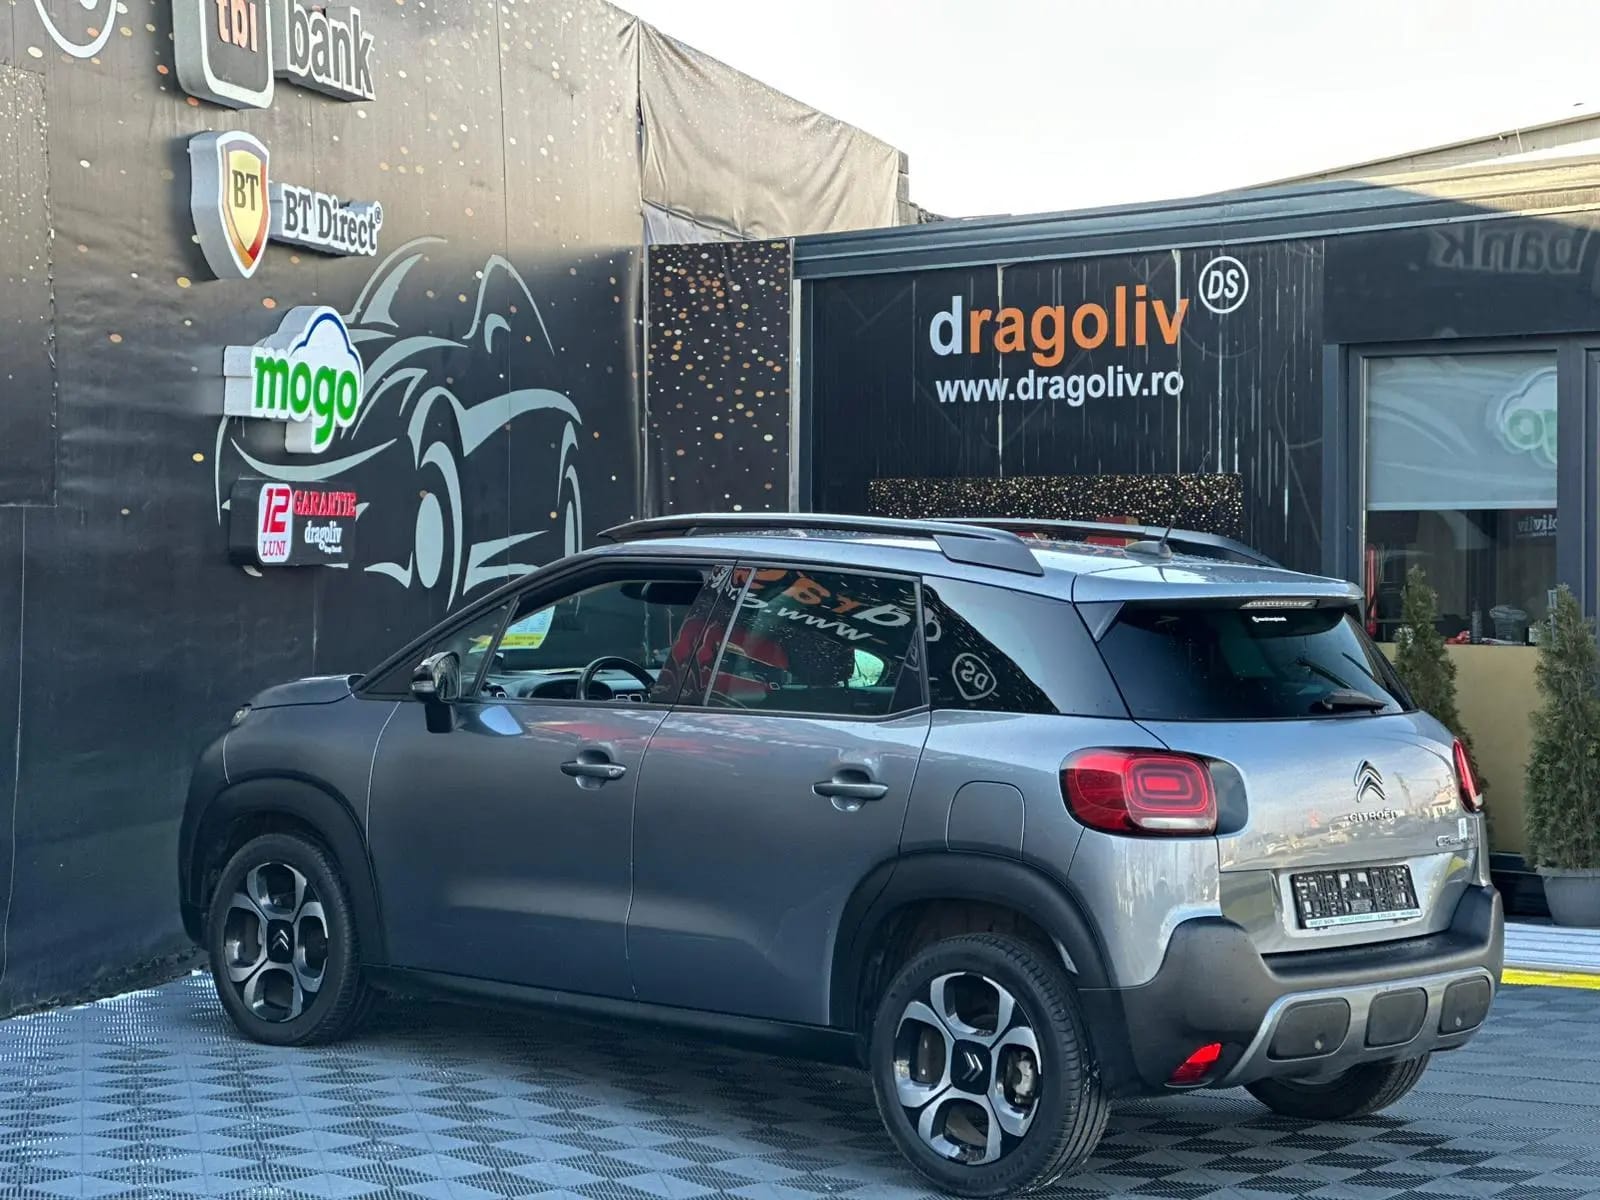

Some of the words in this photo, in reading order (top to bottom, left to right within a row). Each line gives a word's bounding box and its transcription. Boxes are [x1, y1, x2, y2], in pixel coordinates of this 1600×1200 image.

[288, 0, 376, 100] bank
[232, 169, 260, 211] BT
[284, 190, 312, 235] BT
[1207, 268, 1239, 300] DS
[929, 284, 1190, 367] dragoliv
[254, 355, 358, 445] mogo
[935, 366, 1184, 407] www.dragoliv.ro
[262, 488, 291, 533] 12
[262, 541, 287, 556] LUNI
[304, 520, 342, 551] dragoliv
